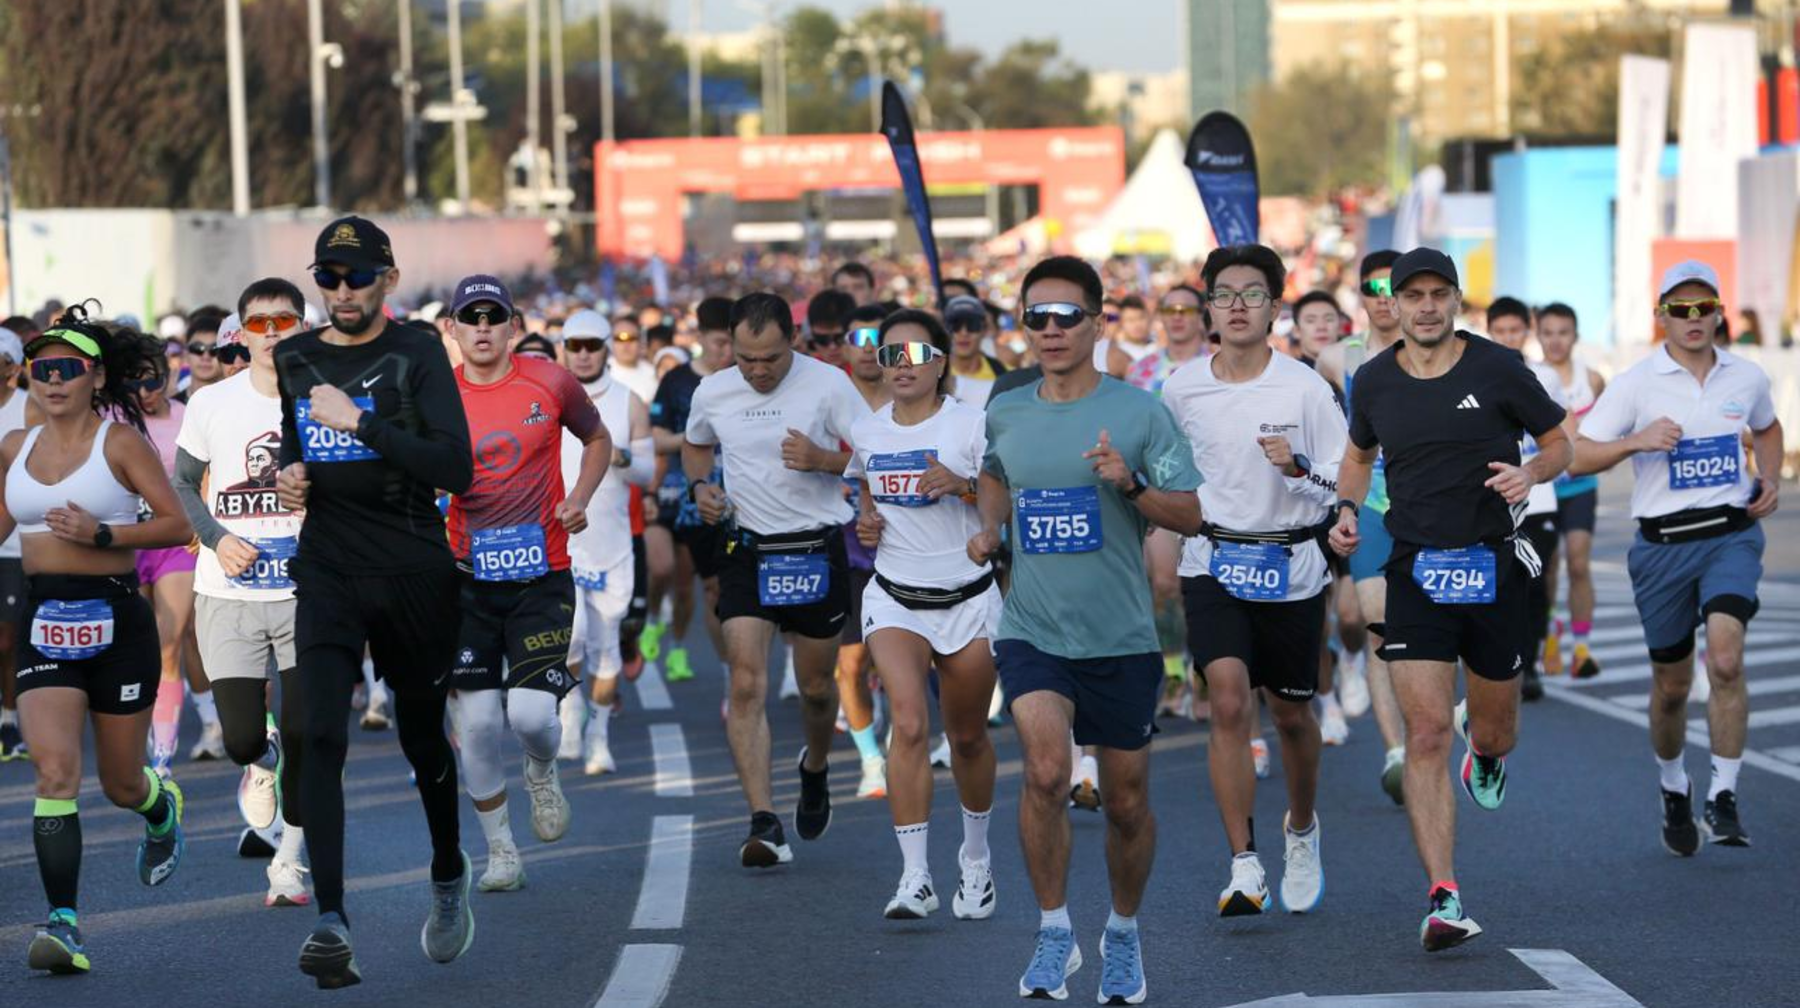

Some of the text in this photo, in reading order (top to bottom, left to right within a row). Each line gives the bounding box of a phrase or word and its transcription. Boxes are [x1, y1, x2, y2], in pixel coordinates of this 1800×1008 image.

[1672, 456, 1736, 479] 15024
[1019, 497, 1026, 507] G
[1027, 514, 1089, 539] 3755
[473, 537, 480, 546] J
[476, 546, 543, 571] 15020
[1418, 552, 1425, 561] E
[768, 574, 821, 594] 5547
[1218, 564, 1280, 588] 2540
[1422, 569, 1486, 590] 2794
[40, 624, 103, 646] 16161
[34, 663, 58, 672] TEAM
